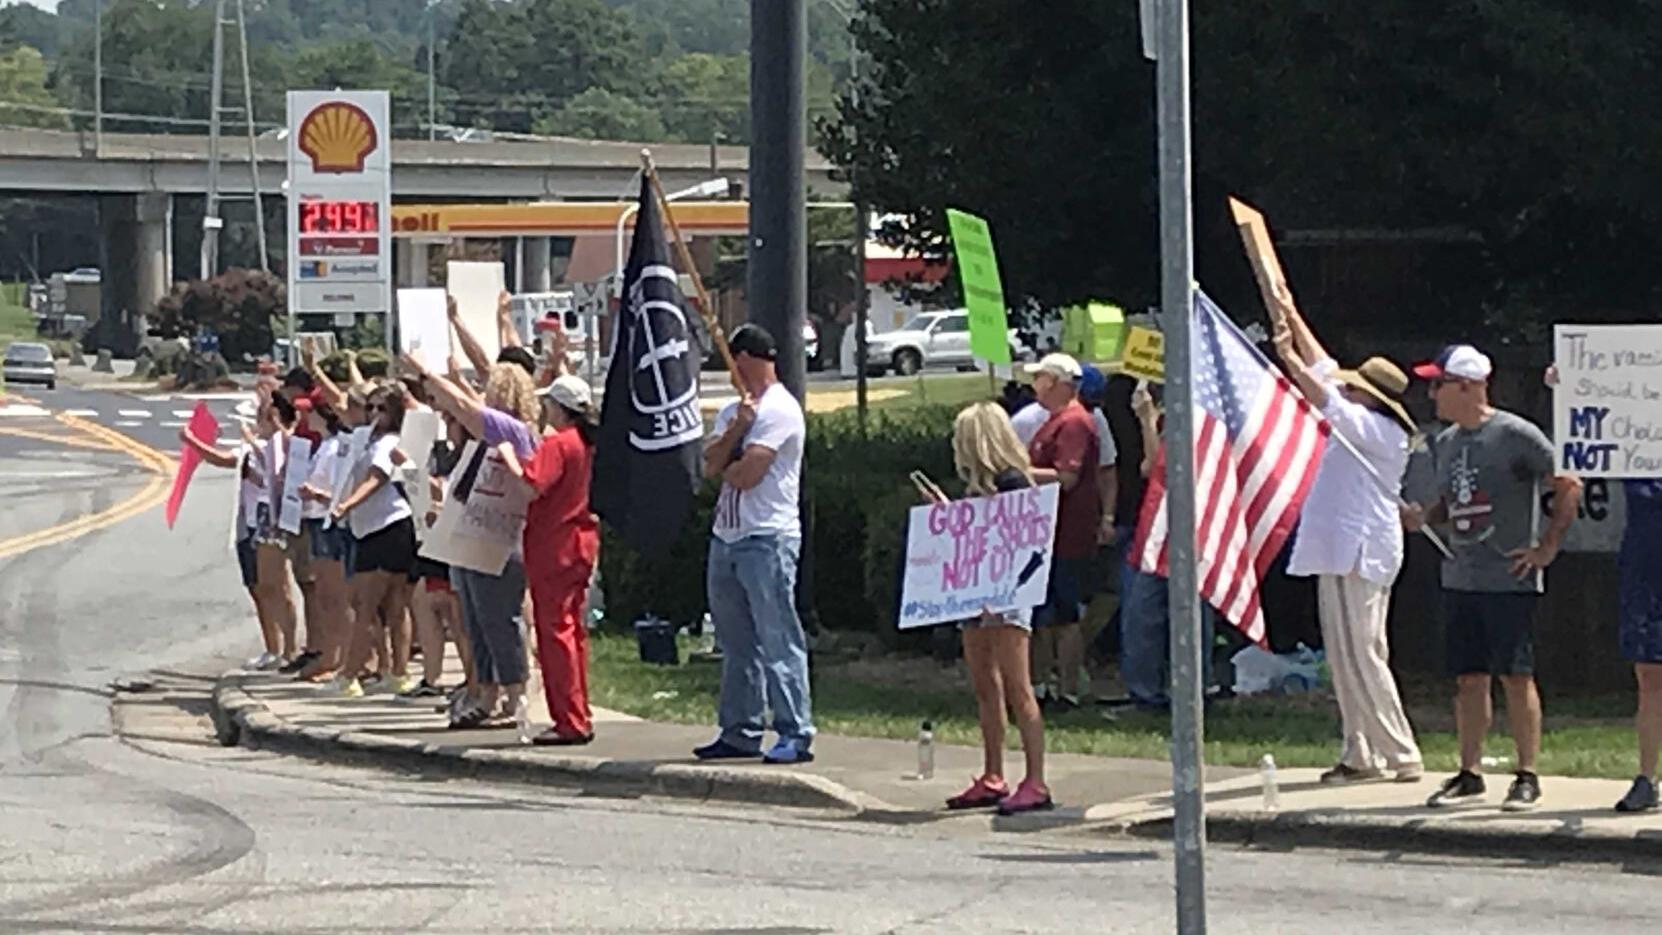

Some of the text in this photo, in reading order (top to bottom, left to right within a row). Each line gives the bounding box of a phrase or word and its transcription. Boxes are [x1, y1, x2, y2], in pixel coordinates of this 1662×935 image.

[1561, 333, 1607, 371] The
[1569, 406, 1610, 440] MY
[1562, 443, 1618, 472] NOT
[928, 488, 1040, 537] GOD CALLS
[952, 527, 990, 565] THE
[998, 513, 1050, 549] SHOTS
[941, 562, 979, 592] NOT
